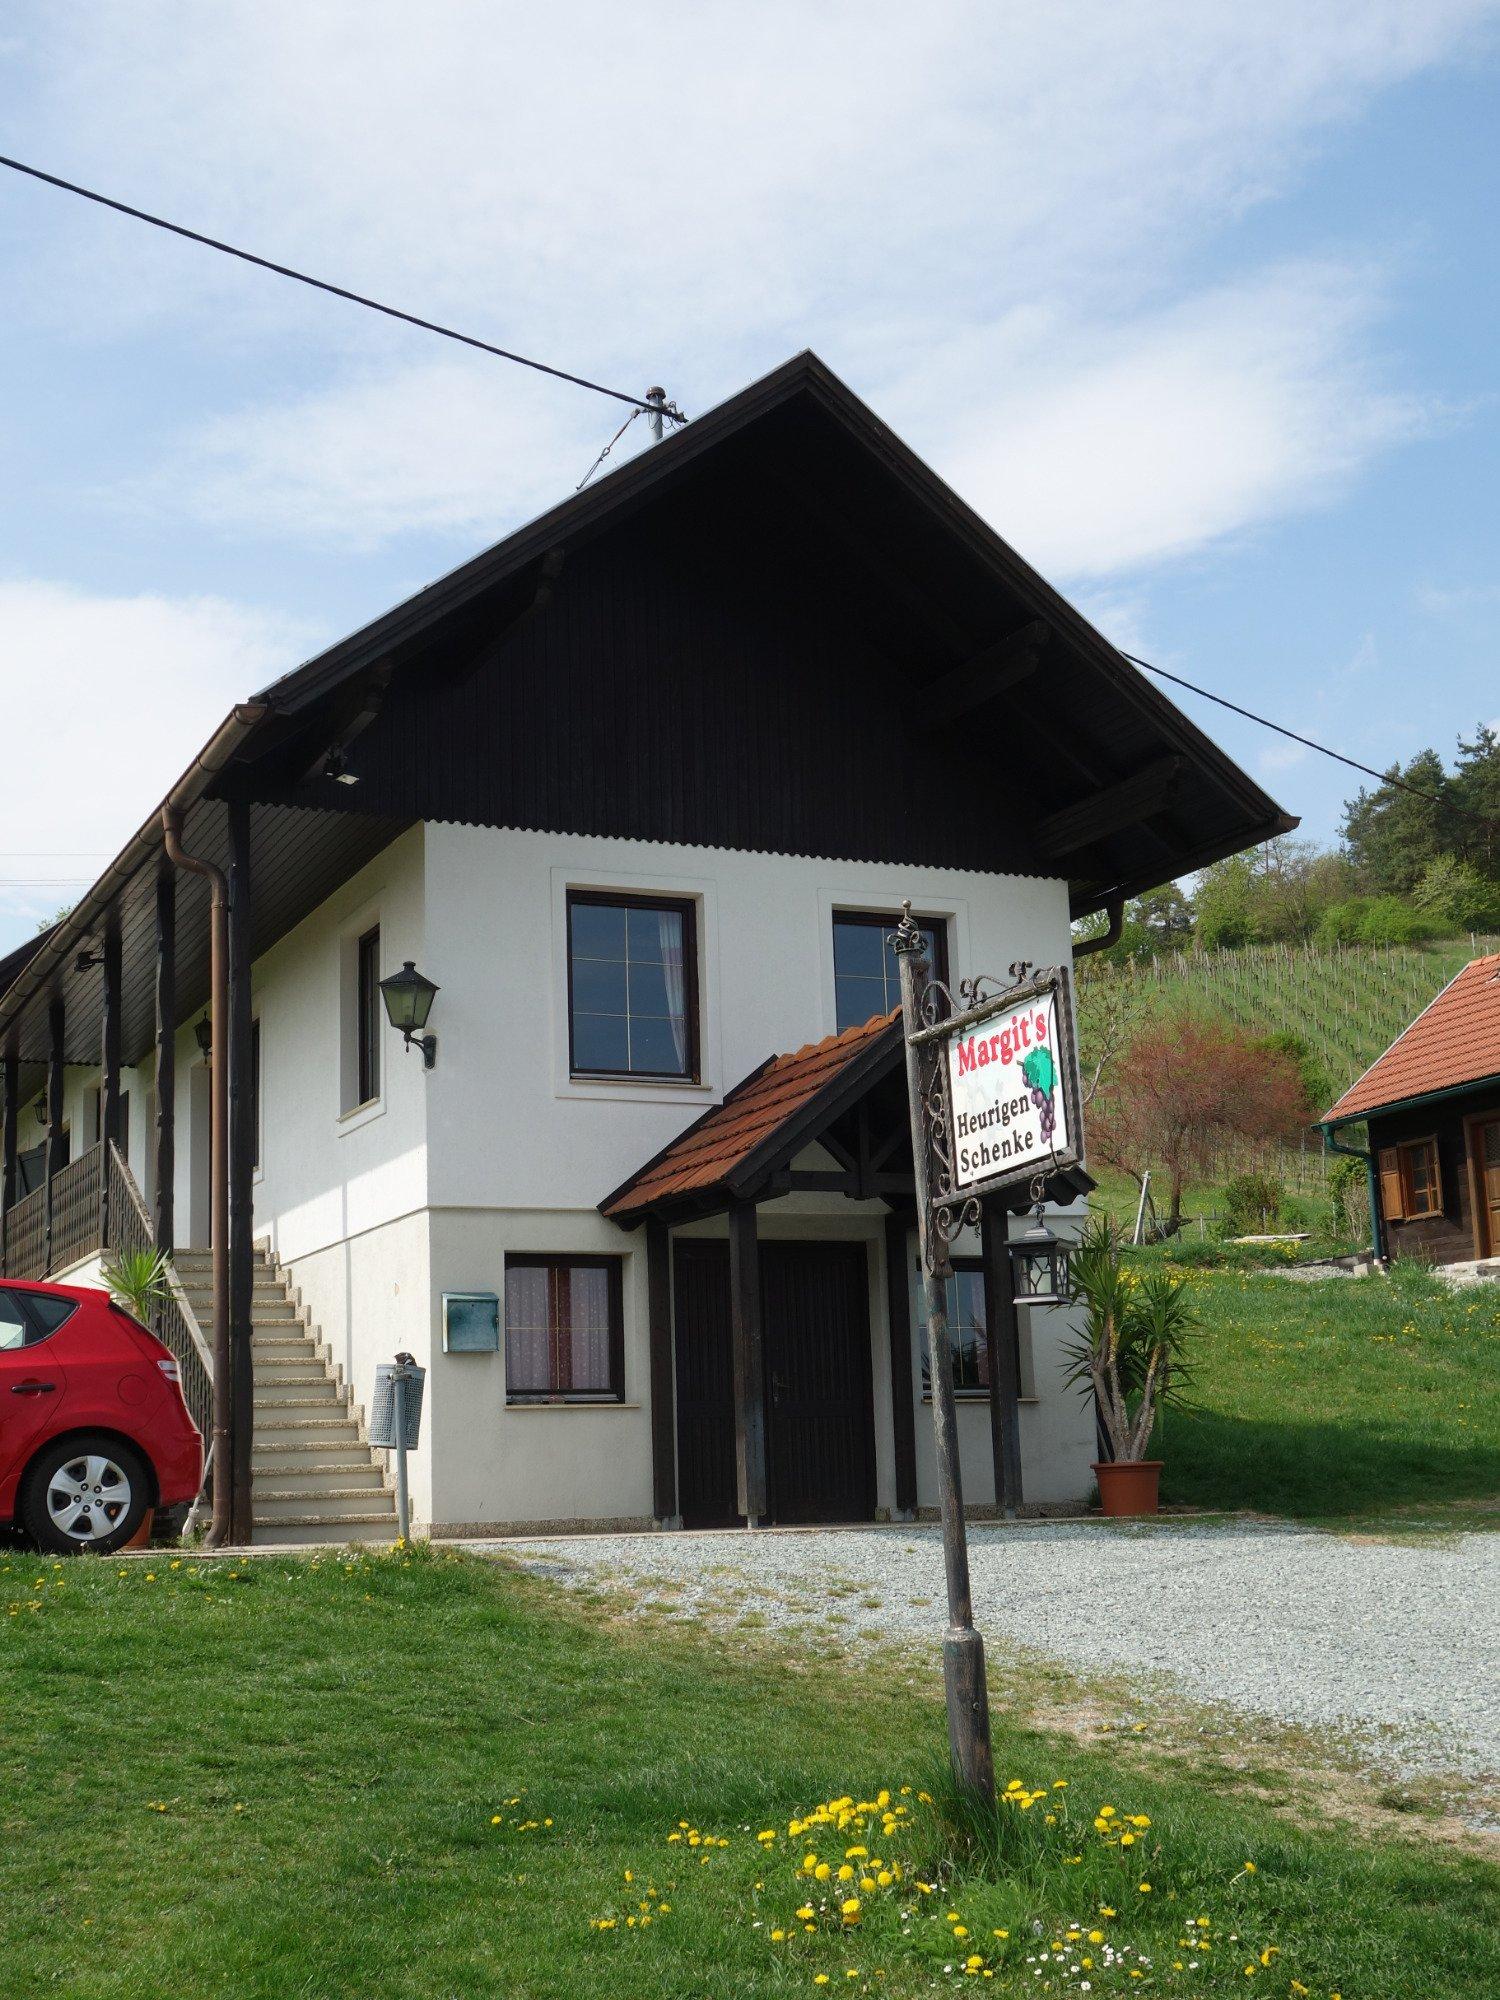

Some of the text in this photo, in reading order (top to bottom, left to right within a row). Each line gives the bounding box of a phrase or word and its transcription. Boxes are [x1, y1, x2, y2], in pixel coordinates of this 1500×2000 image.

[957, 1009, 1047, 1076] Margit's
[957, 1094, 1030, 1138] Heurigen
[960, 1130, 1033, 1172] Schenke
